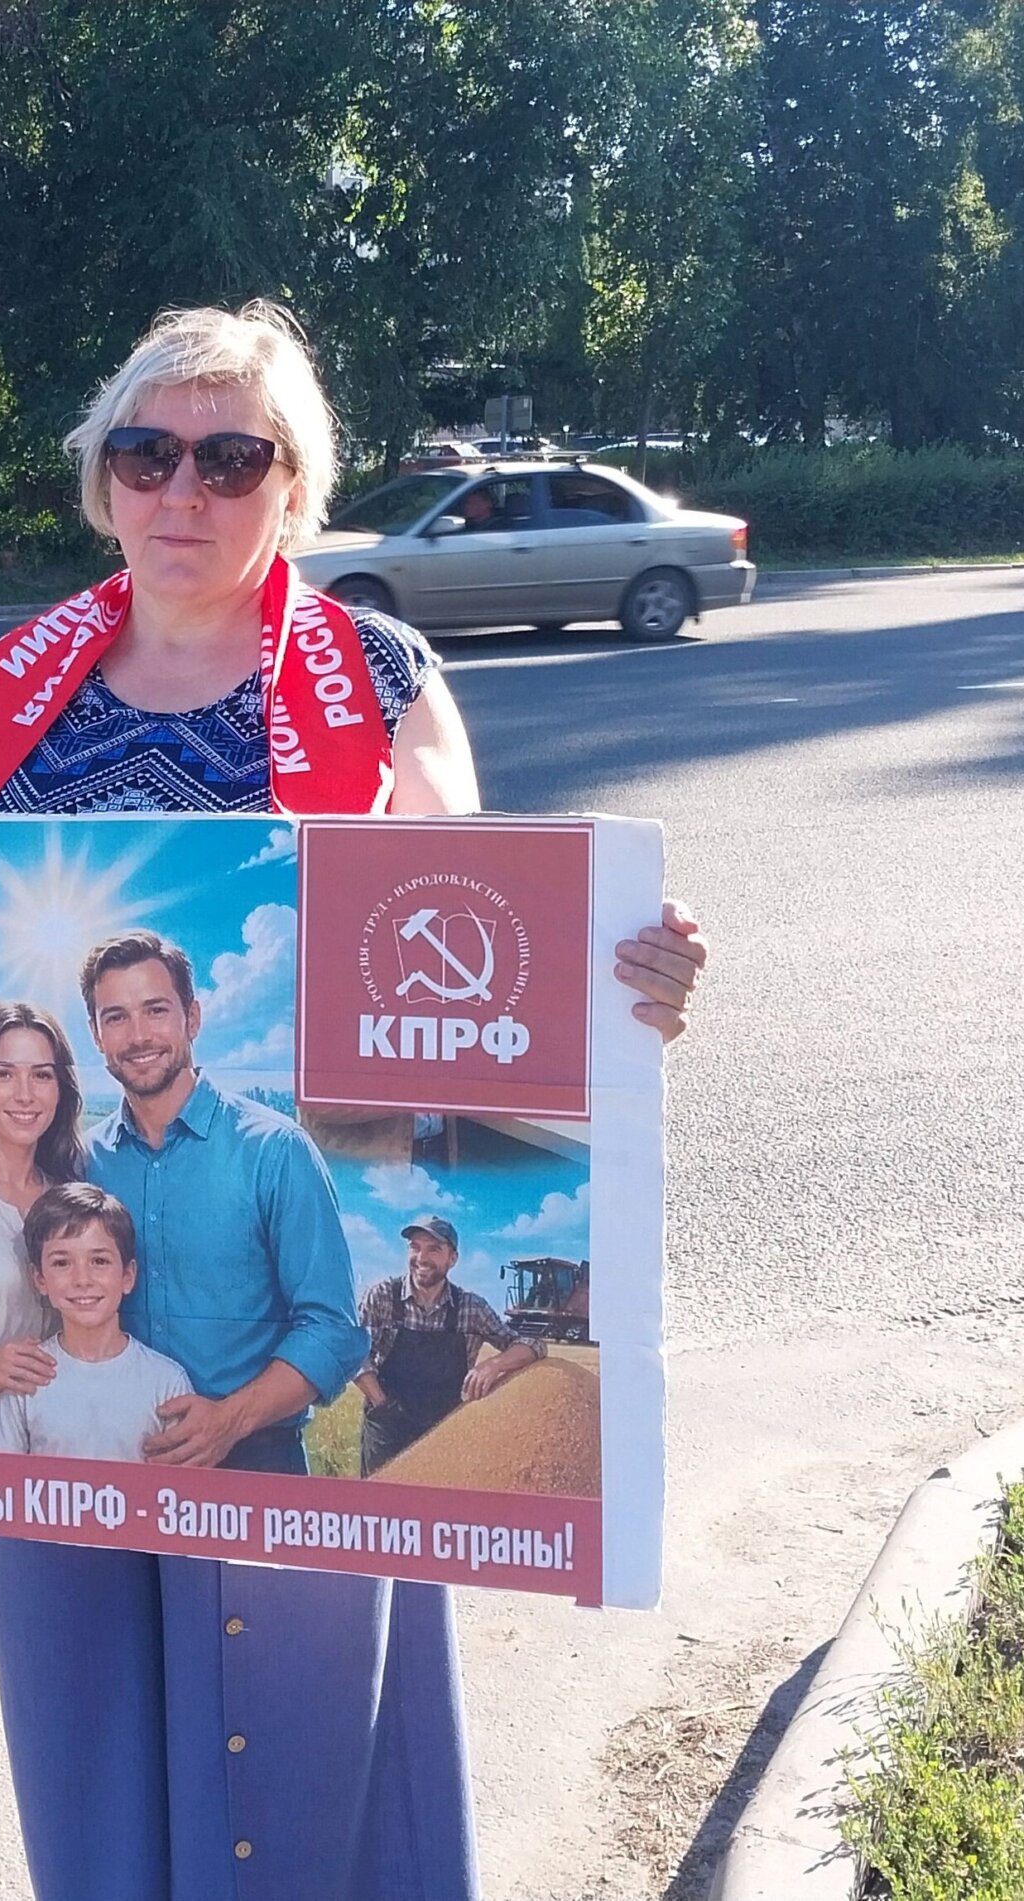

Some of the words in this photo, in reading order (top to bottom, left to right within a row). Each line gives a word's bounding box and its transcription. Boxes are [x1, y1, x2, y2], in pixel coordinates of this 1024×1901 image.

[363, 901, 389, 935] ТРУД
[393, 873, 510, 911] НАРОДОВЛАСТИЕ
[359, 946, 383, 1002] РОССИЯ
[506, 917, 531, 1006] СОЦИАЛИЗМ
[359, 1014, 530, 1064] КПРФ
[24, 1478, 127, 1530] КПРФ
[157, 1488, 253, 1541] Залог
[264, 1507, 422, 1557] развития
[432, 1521, 574, 1570] страны!
